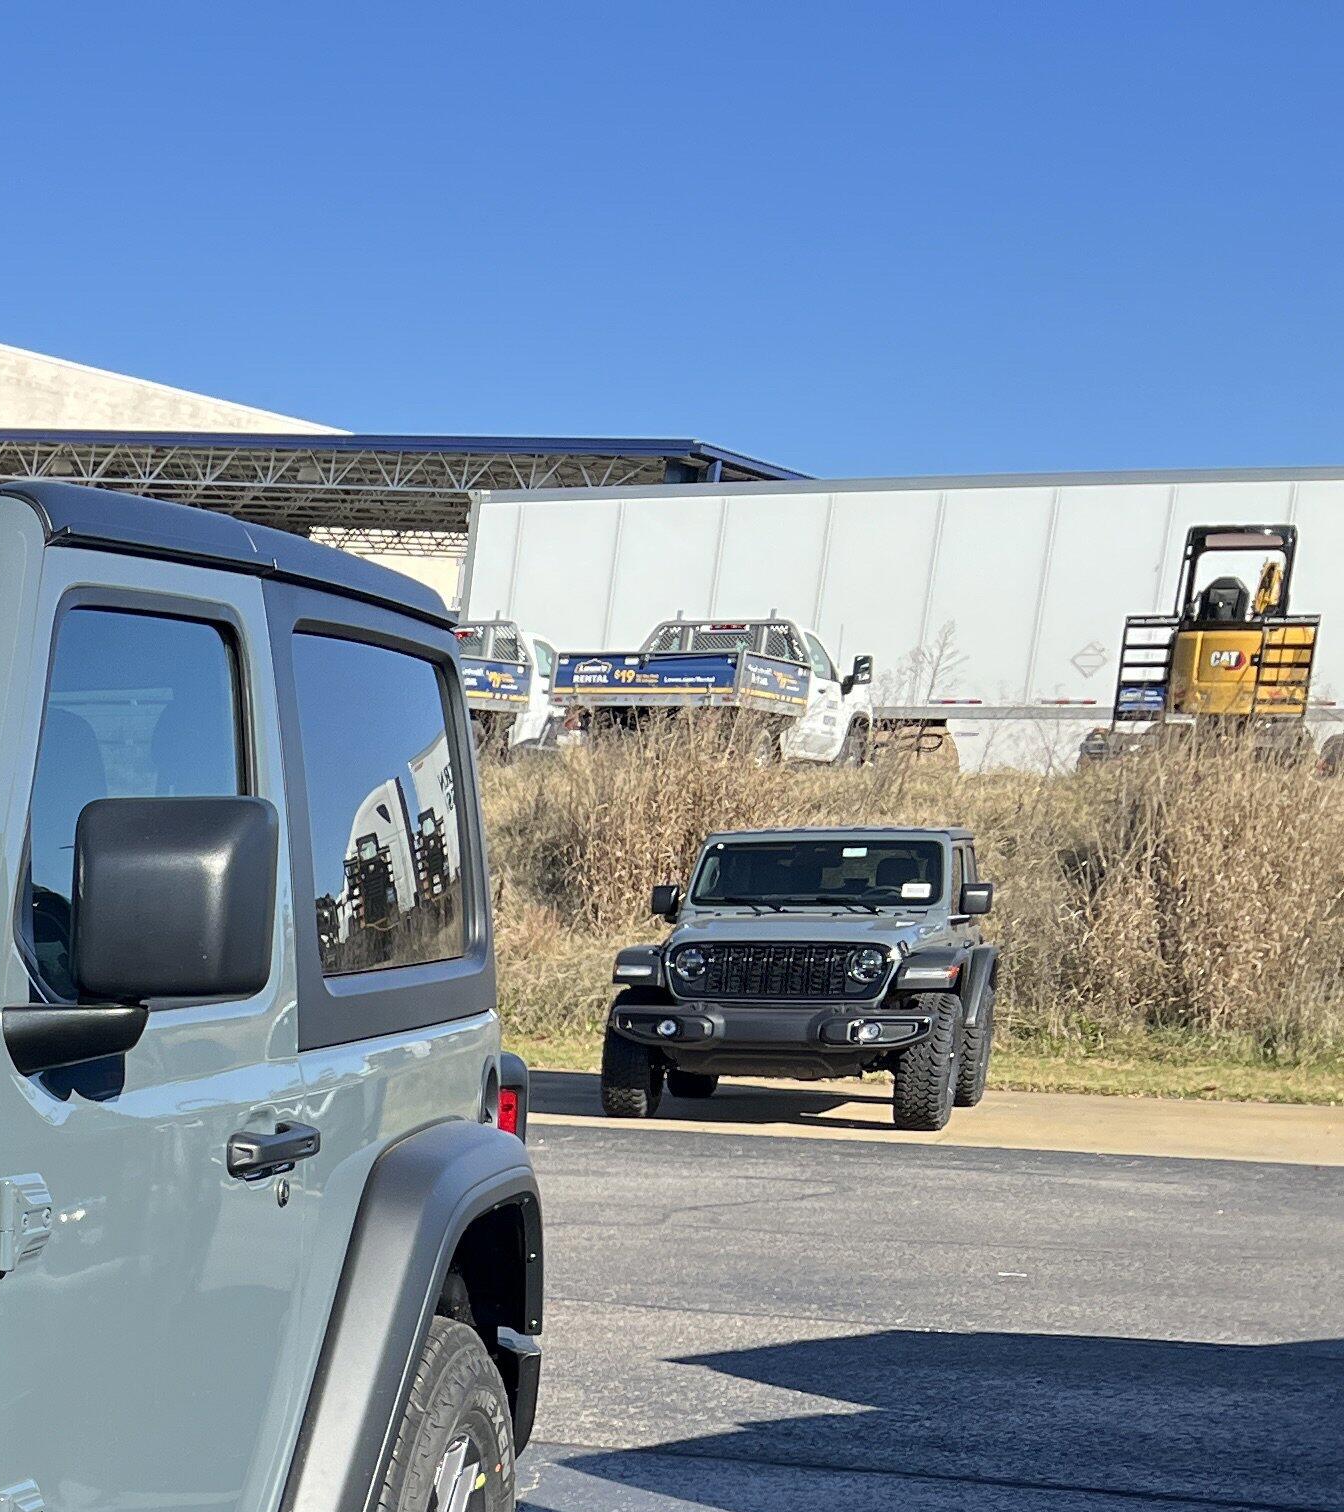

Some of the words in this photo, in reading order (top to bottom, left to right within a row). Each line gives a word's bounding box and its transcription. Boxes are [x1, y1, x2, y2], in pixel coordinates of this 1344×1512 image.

[1210, 650, 1240, 668] CAT
[573, 674, 609, 683] RENTAL
[614, 669, 636, 684] $19
[474, 1389, 511, 1482] NEXEN
